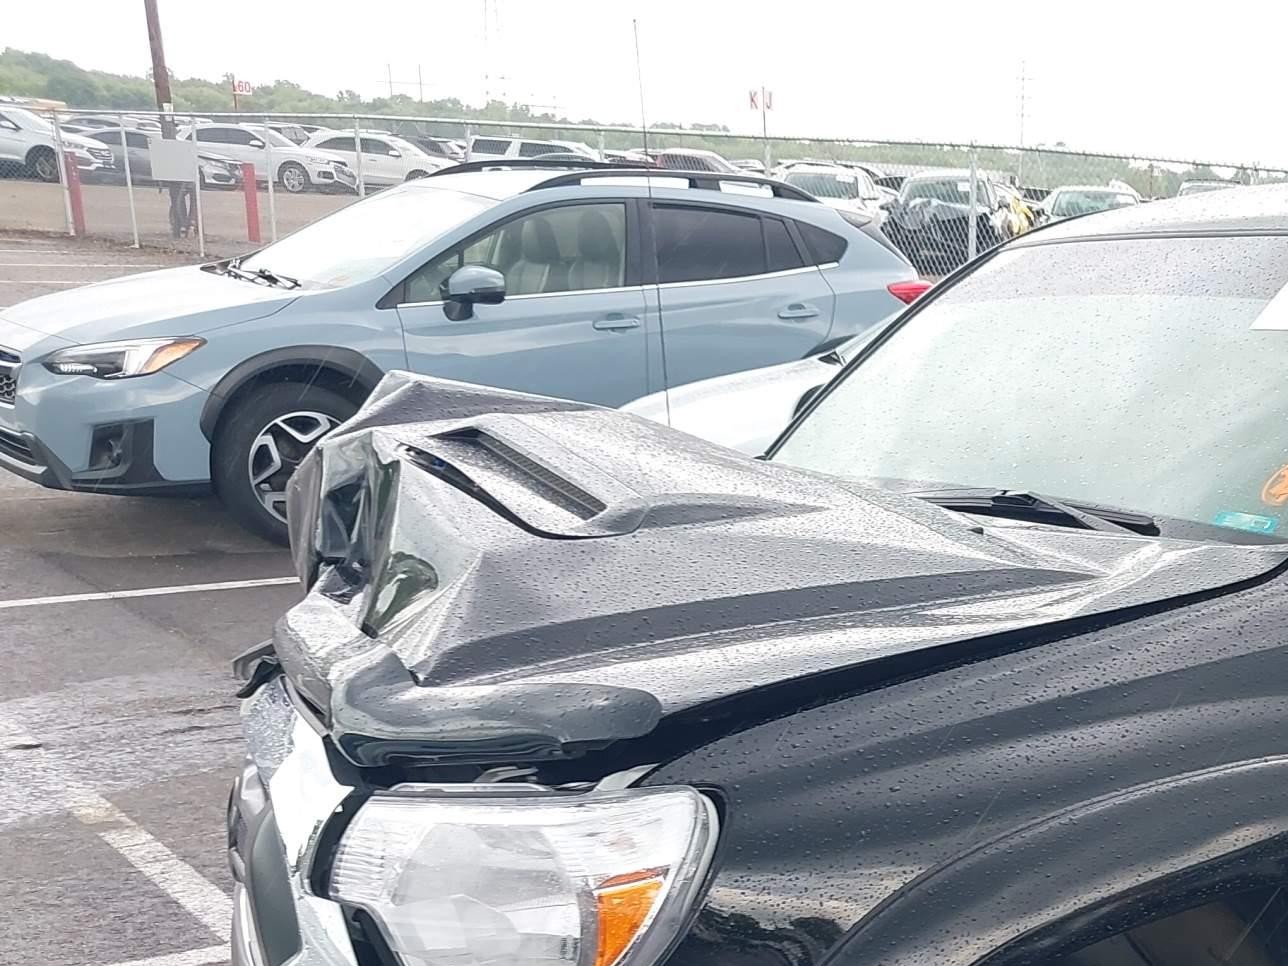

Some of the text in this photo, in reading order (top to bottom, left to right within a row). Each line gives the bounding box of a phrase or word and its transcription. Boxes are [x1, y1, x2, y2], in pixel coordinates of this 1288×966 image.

[237, 80, 251, 93] 60
[749, 90, 758, 110] K
[766, 91, 773, 110] J
